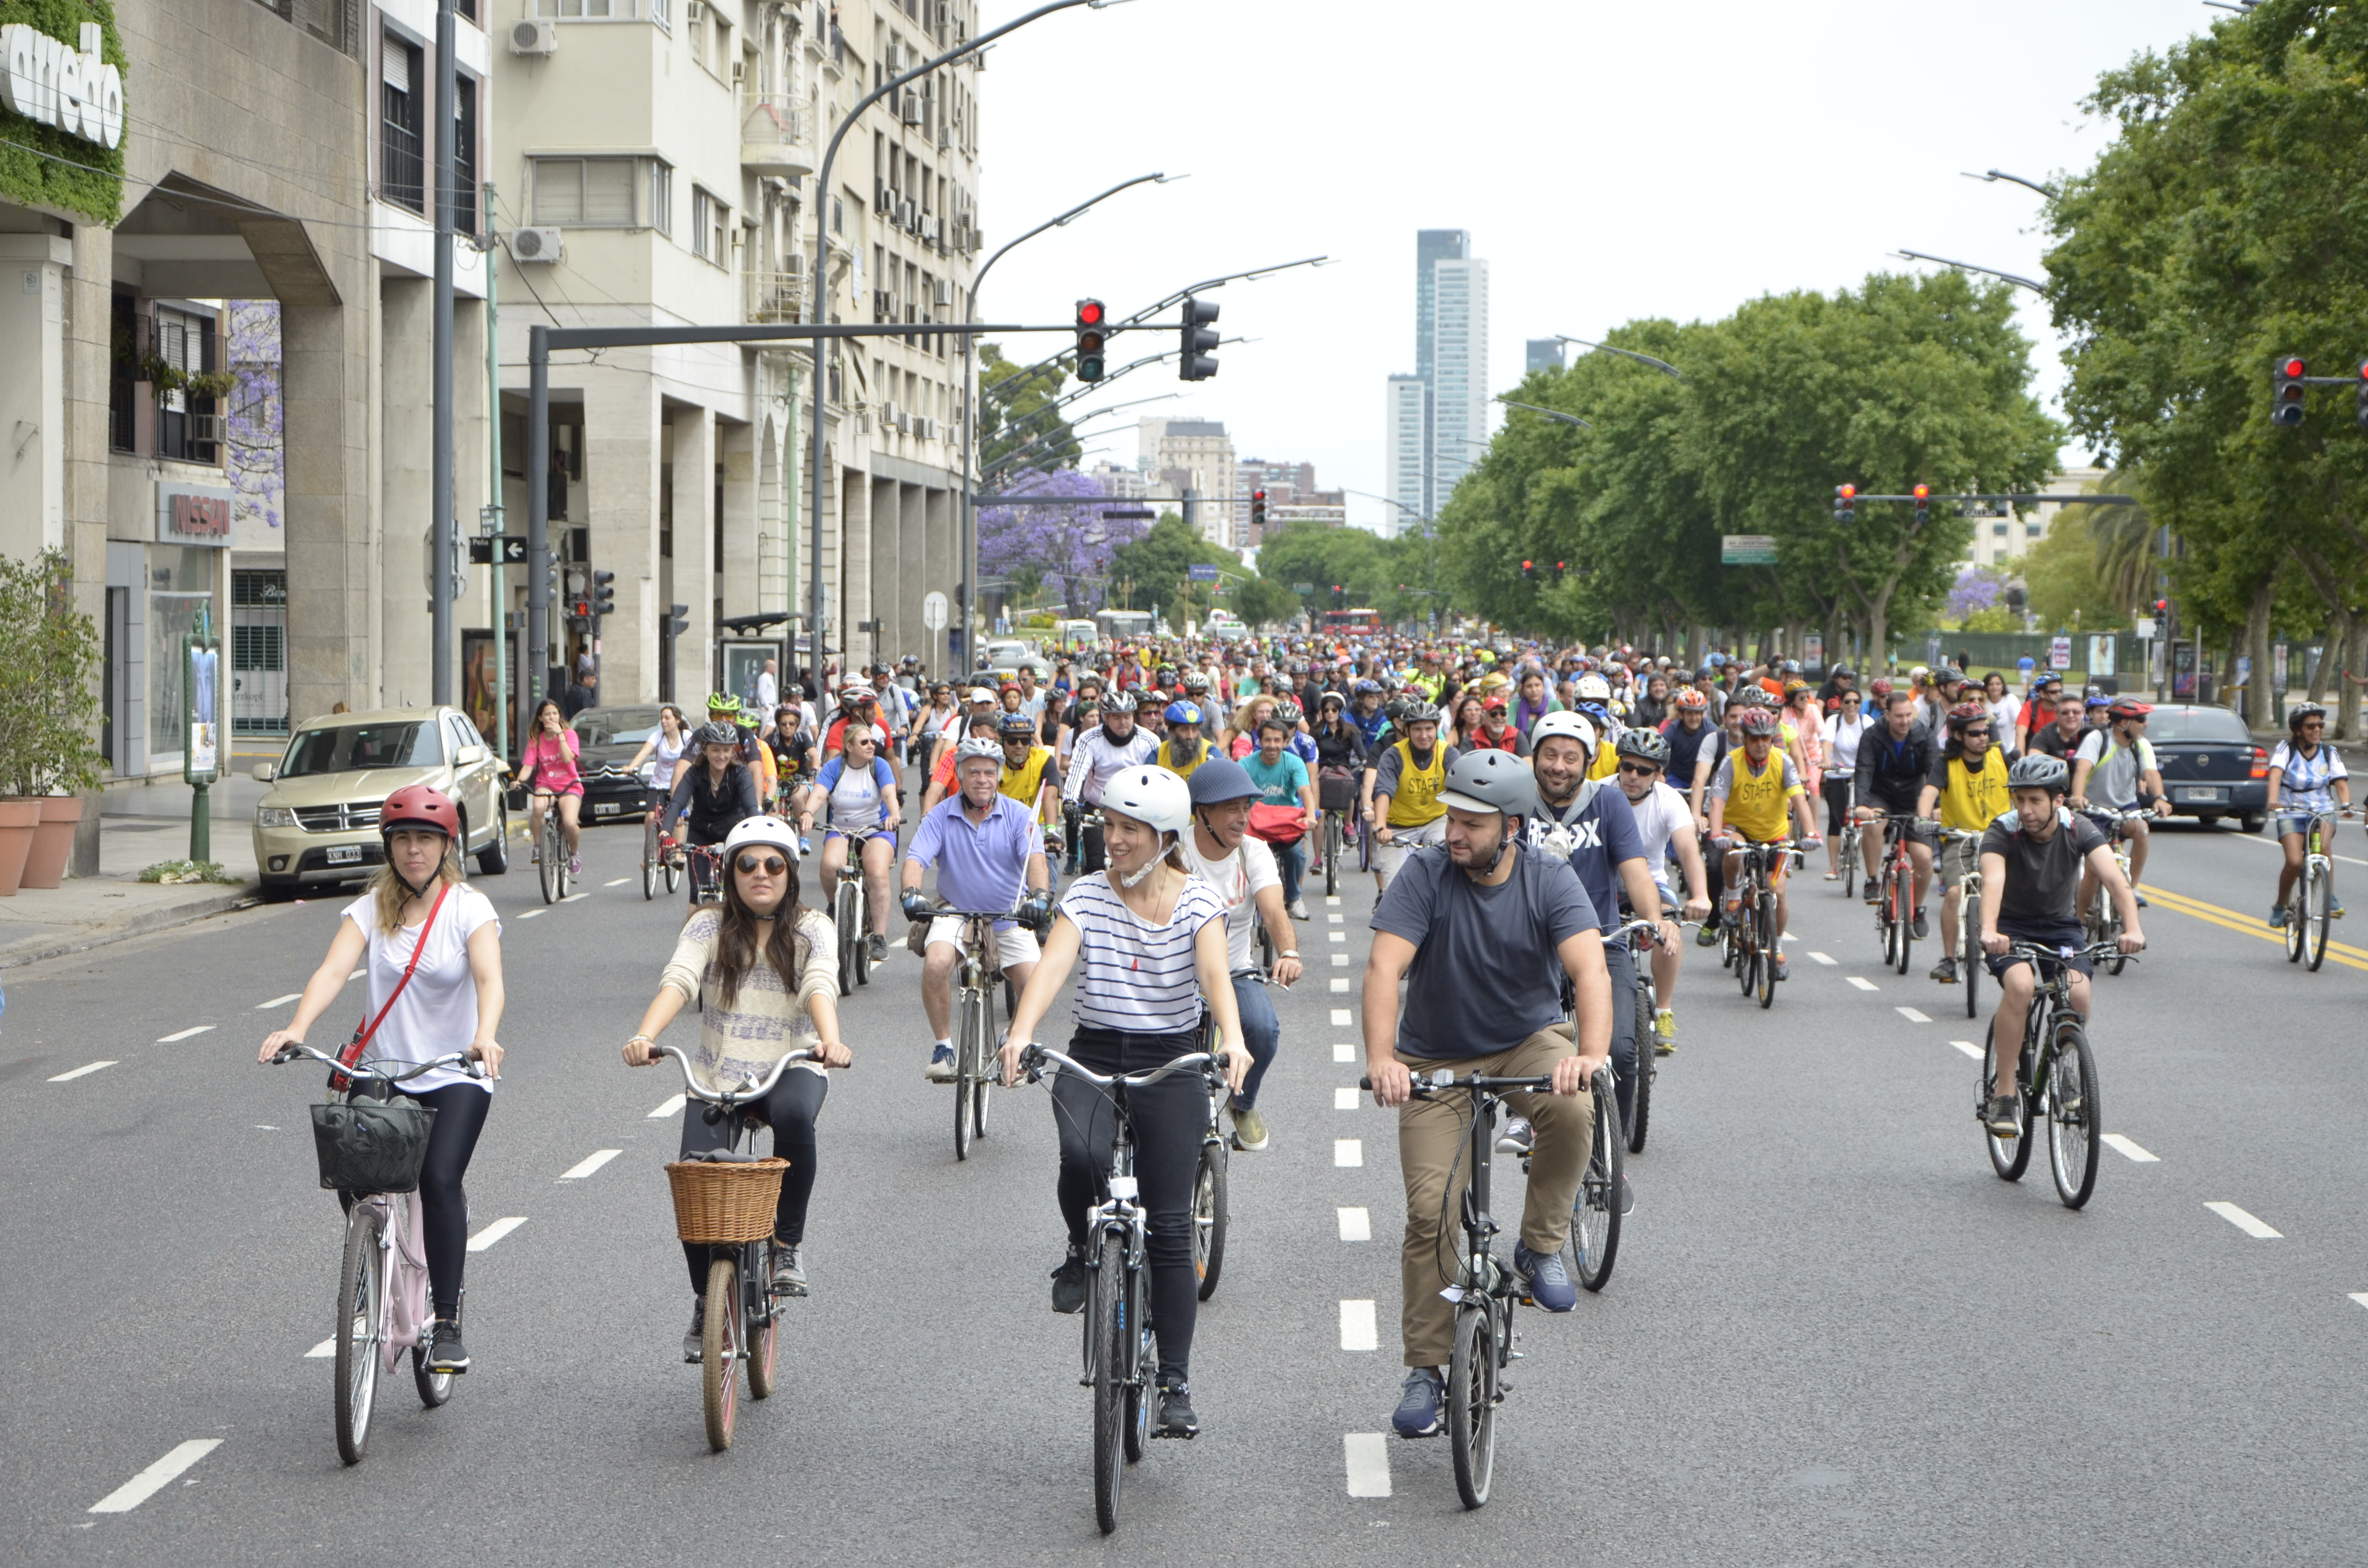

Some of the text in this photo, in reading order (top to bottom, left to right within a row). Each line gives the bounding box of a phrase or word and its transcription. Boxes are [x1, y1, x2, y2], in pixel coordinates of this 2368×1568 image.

[172, 493, 230, 535] NISSAN
[1408, 777, 1440, 794] STAFF
[1743, 782, 1772, 801] STAFF
[1967, 778, 1996, 797] STAFF
[329, 849, 360, 860] KNH 033
